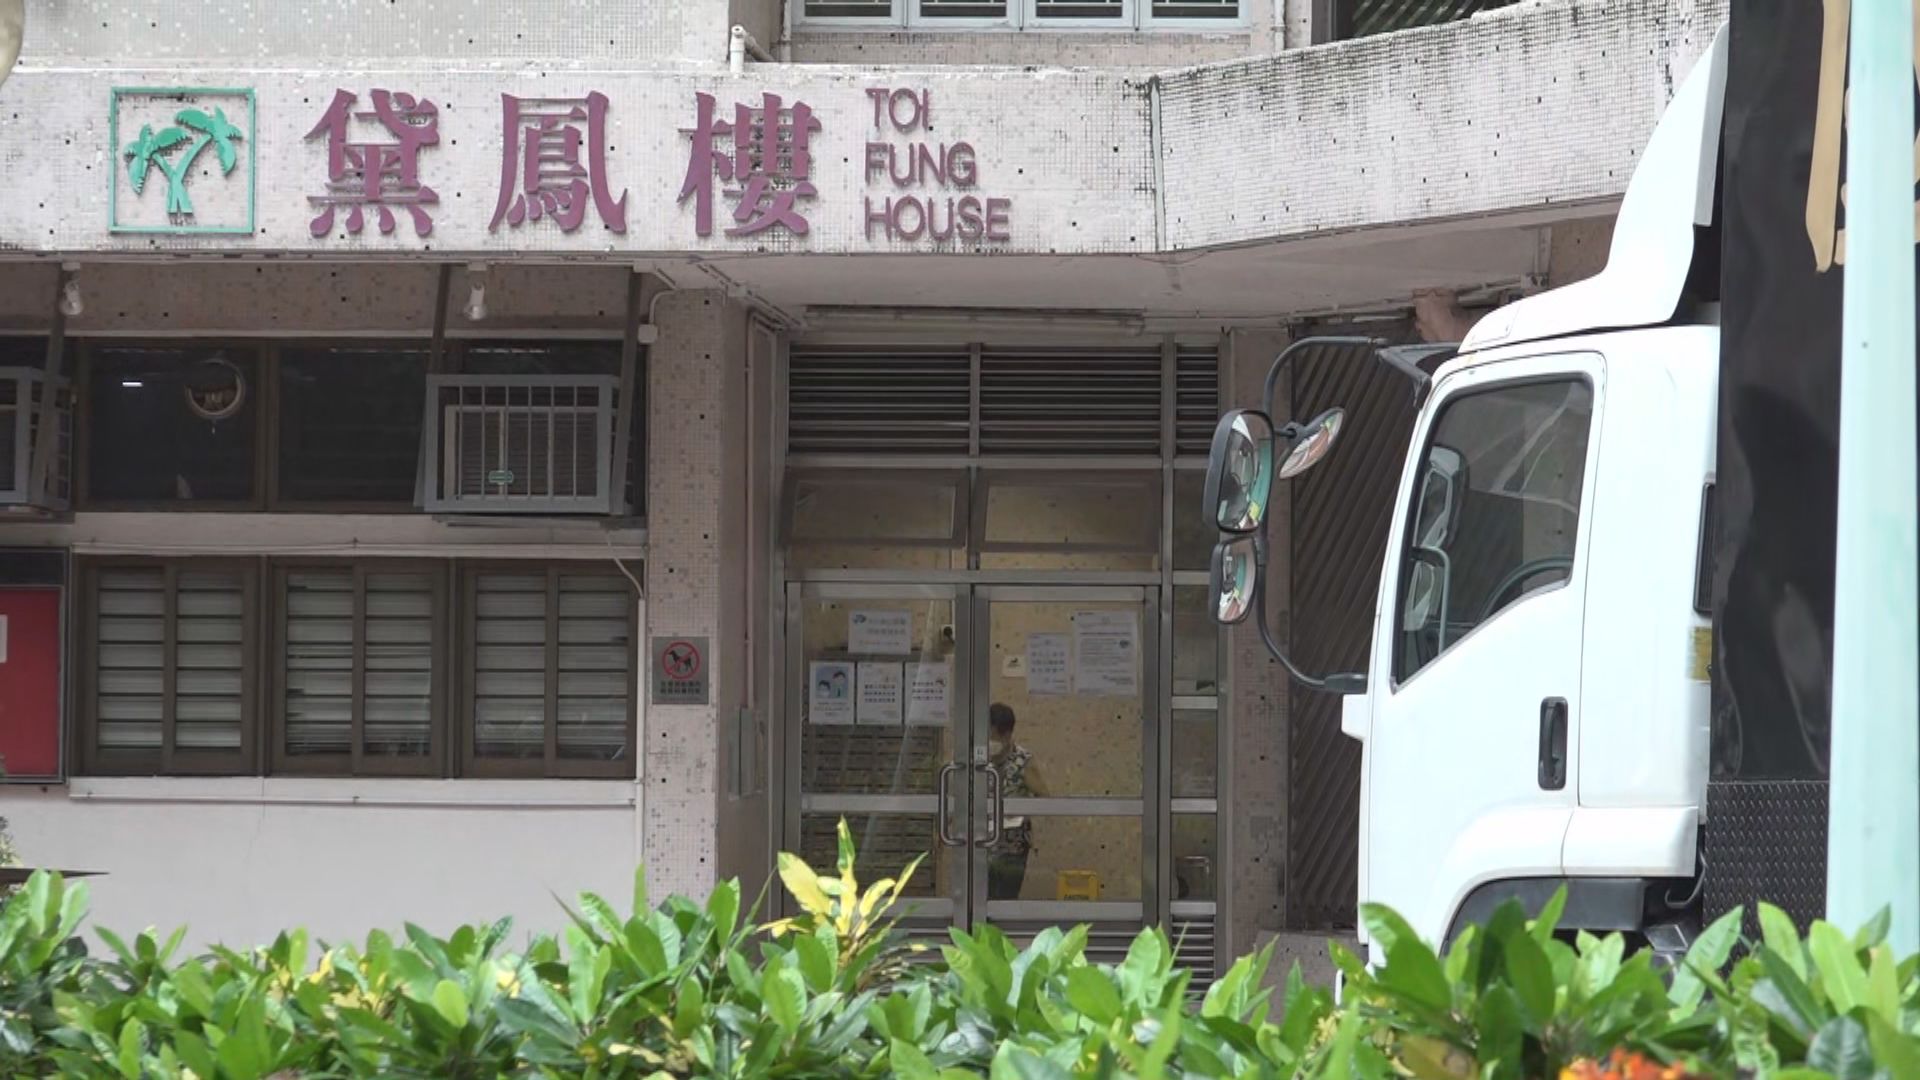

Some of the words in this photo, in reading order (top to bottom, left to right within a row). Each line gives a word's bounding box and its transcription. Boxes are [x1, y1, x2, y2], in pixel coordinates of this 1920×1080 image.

[865, 88, 929, 131] TOI
[304, 87, 823, 238] 黛鳳樓
[865, 142, 977, 189] FUNG
[864, 194, 1012, 241] HOUSE
